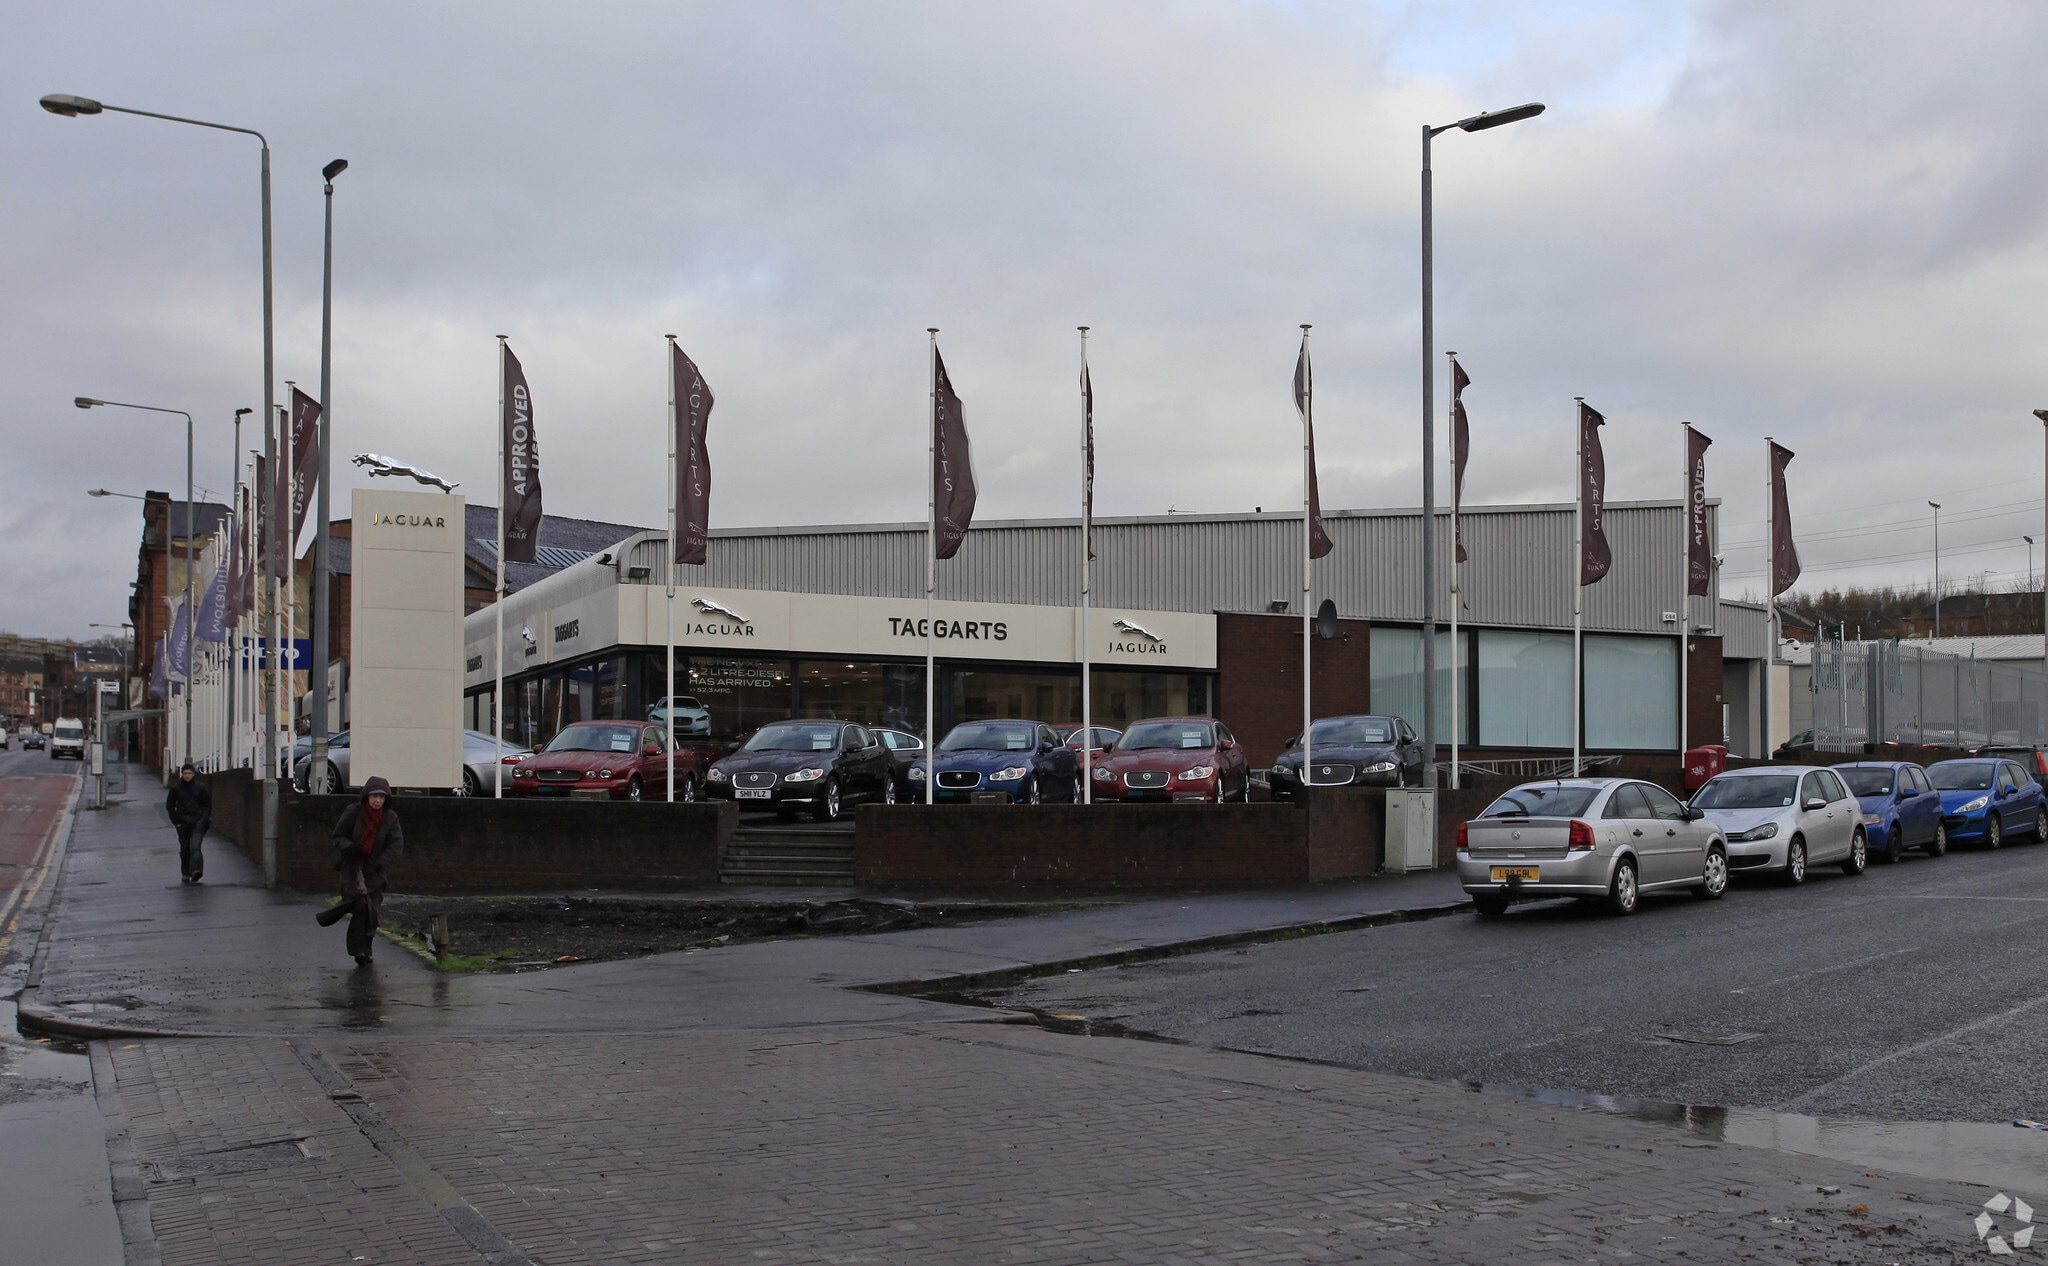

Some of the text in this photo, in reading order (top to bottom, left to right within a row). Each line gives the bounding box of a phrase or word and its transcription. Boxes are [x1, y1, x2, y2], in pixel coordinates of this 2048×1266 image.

[937, 370, 953, 492] AGGARTS
[511, 384, 528, 496] APPROVED
[373, 513, 445, 528] JAGUAR
[554, 619, 579, 643] TAGGARTS
[685, 623, 755, 636] JAGUAR
[888, 617, 1008, 641] TAGGARTS
[1108, 642, 1167, 654] JAGUAR
[710, 669, 745, 677] LITRE
[747, 669, 790, 678] DIESEL
[689, 678, 774, 688] HAS ARRIVED.
[753, 790, 767, 798] YLZ
